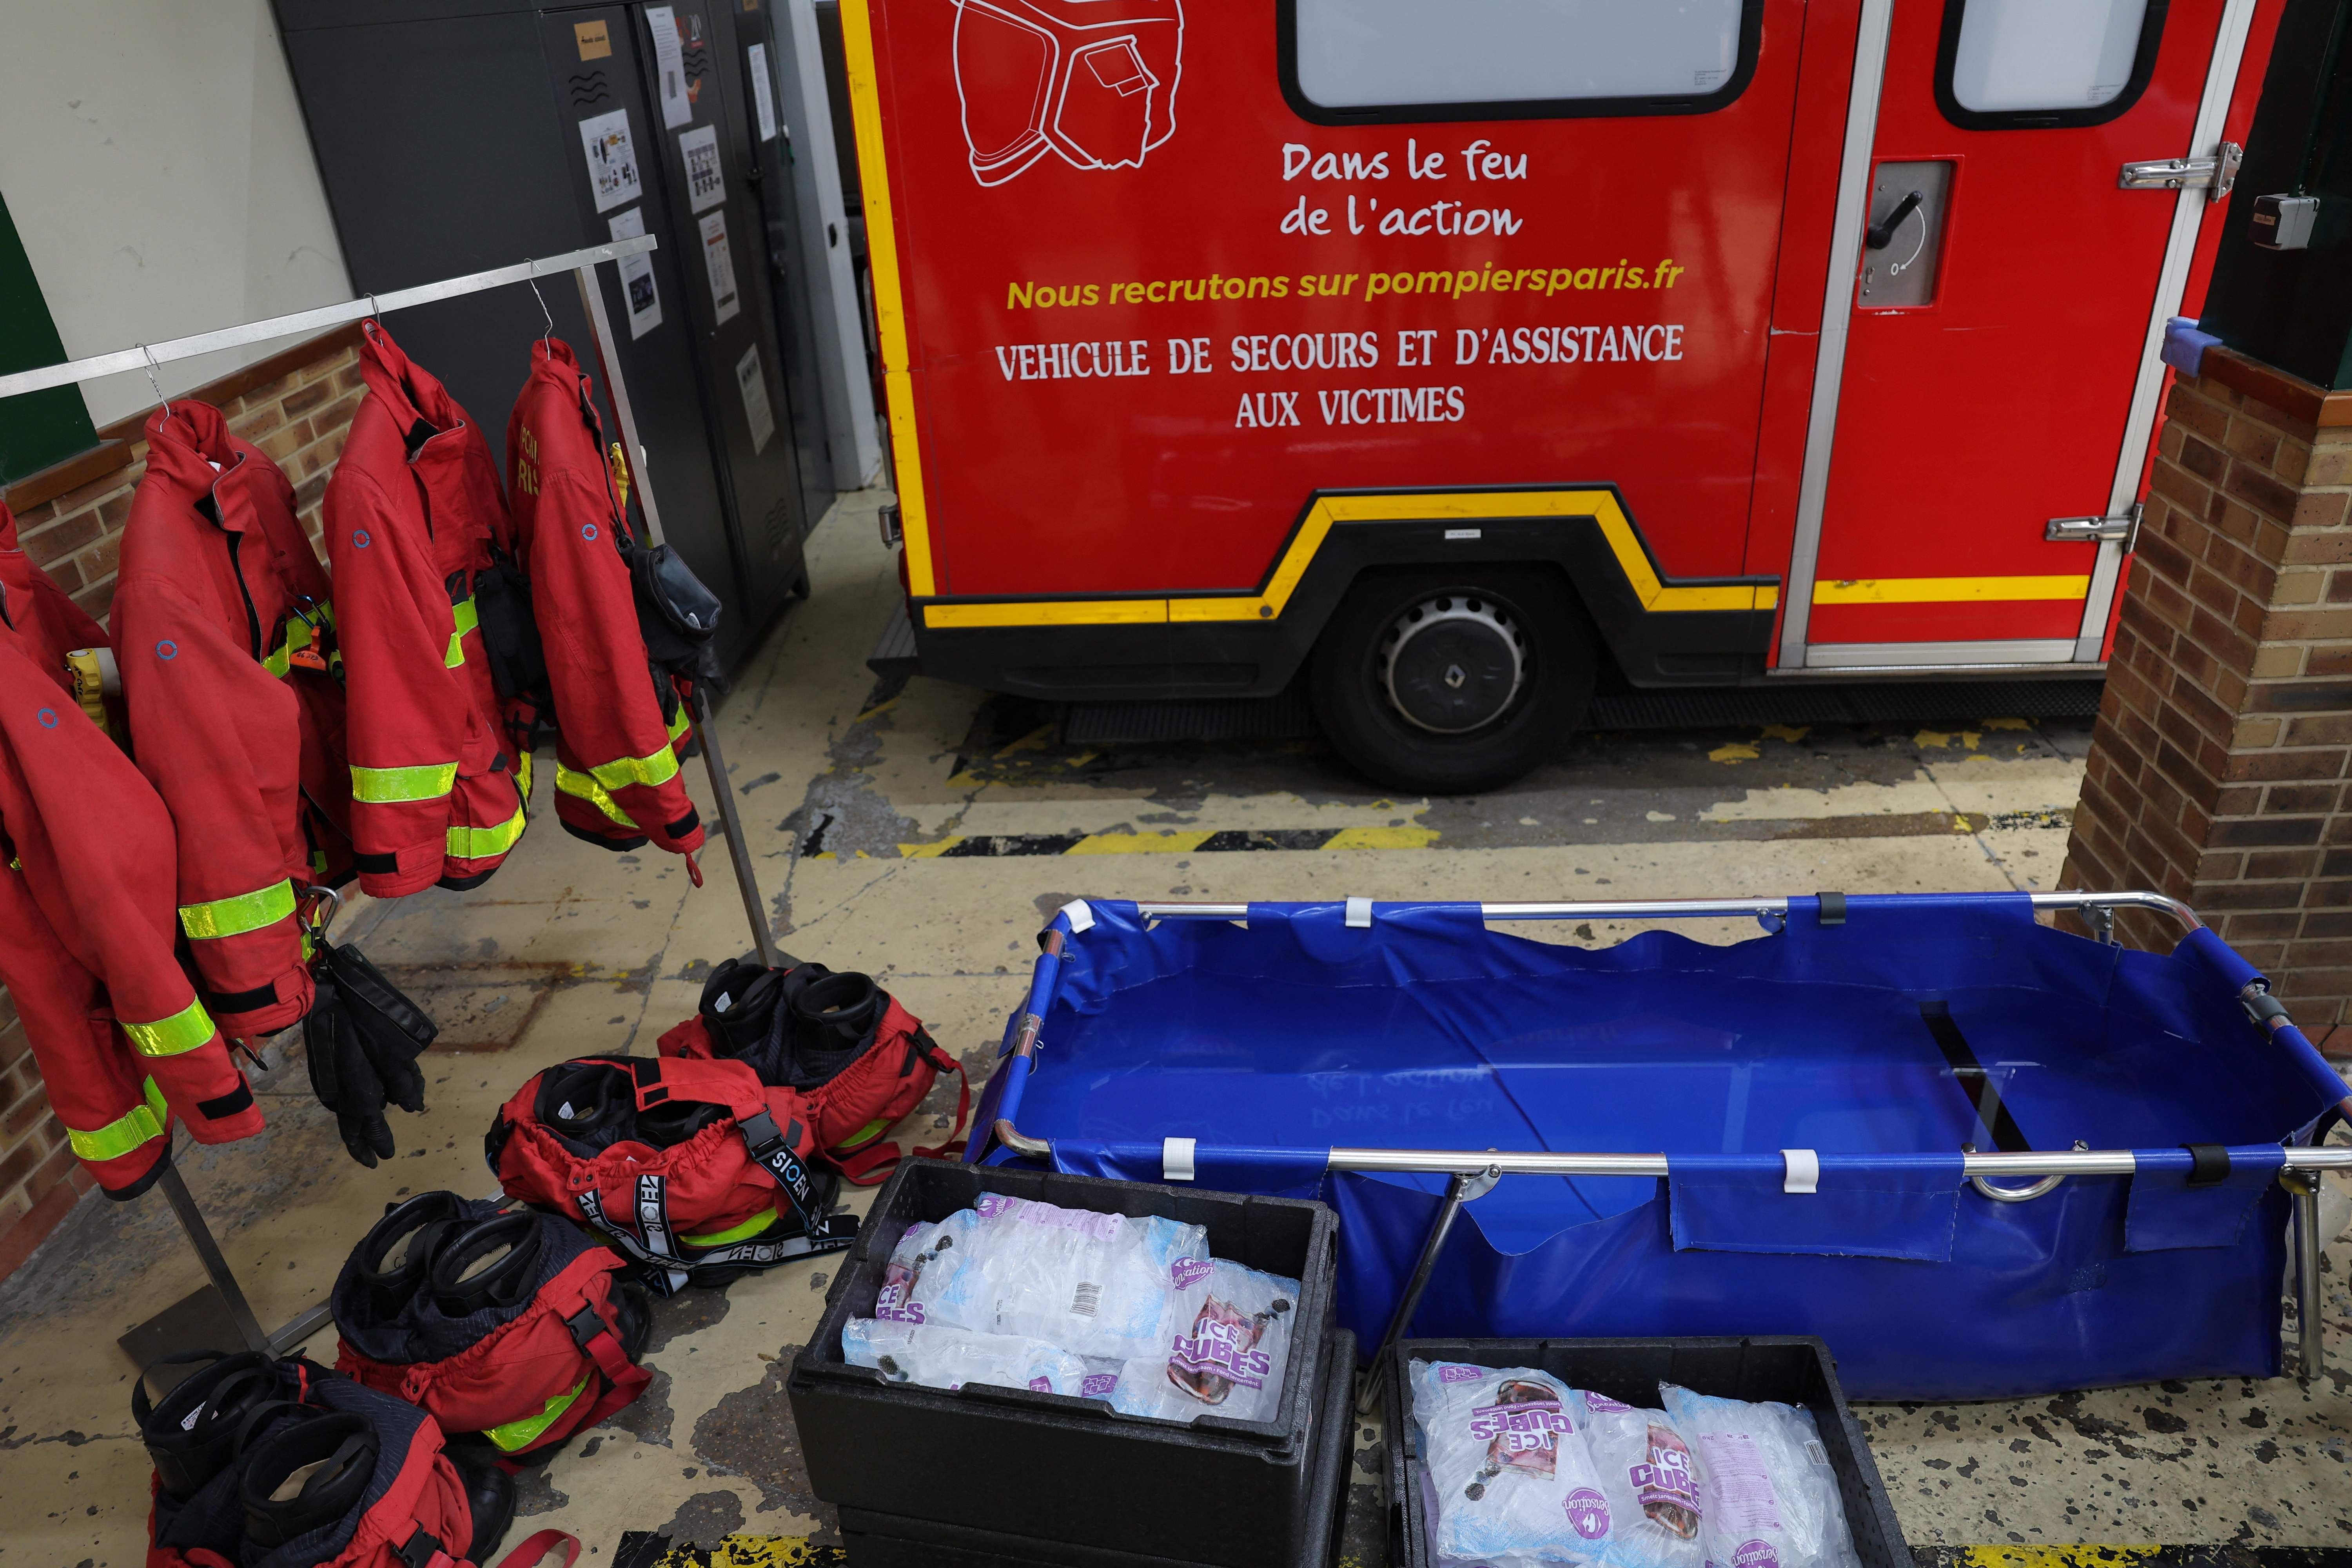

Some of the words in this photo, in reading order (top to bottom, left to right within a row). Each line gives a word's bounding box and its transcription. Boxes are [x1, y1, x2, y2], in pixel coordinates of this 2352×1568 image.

[1282, 142, 1390, 181] Dans
[1407, 138, 1447, 180] le
[1460, 139, 1528, 181] feu
[1279, 194, 1332, 236] de
[1347, 194, 1523, 236] l'action
[1007, 281, 1100, 310] Nous
[1109, 273, 1290, 305] recrutons
[1297, 273, 1359, 297] sur
[1364, 258, 1685, 302] pompiersparis.fr
[995, 339, 1151, 381] VEHICULE
[1167, 337, 1213, 374] DE
[1230, 331, 1379, 372] SECOURS
[1397, 330, 1438, 367] ET
[1455, 324, 1684, 365] D'ASSISTANCE
[1235, 391, 1301, 428] AUX
[1318, 385, 1465, 426] VICTIMES
[771, 1151, 810, 1202] SIOEN
[878, 1285, 900, 1304] CE
[1201, 1318, 1238, 1345] ICE
[1172, 1334, 1270, 1376] CUBES
[1216, 1368, 1230, 1377] Fond
[1230, 1373, 1259, 1387] lentement
[1470, 1410, 1574, 1440] CUBES
[1508, 1433, 1550, 1450] ICE
[1655, 1449, 1689, 1472] ICE
[1629, 1464, 1700, 1506] CUBE
[1561, 1492, 1609, 1516] Sensation
[1731, 1546, 1778, 1566] Sensation
